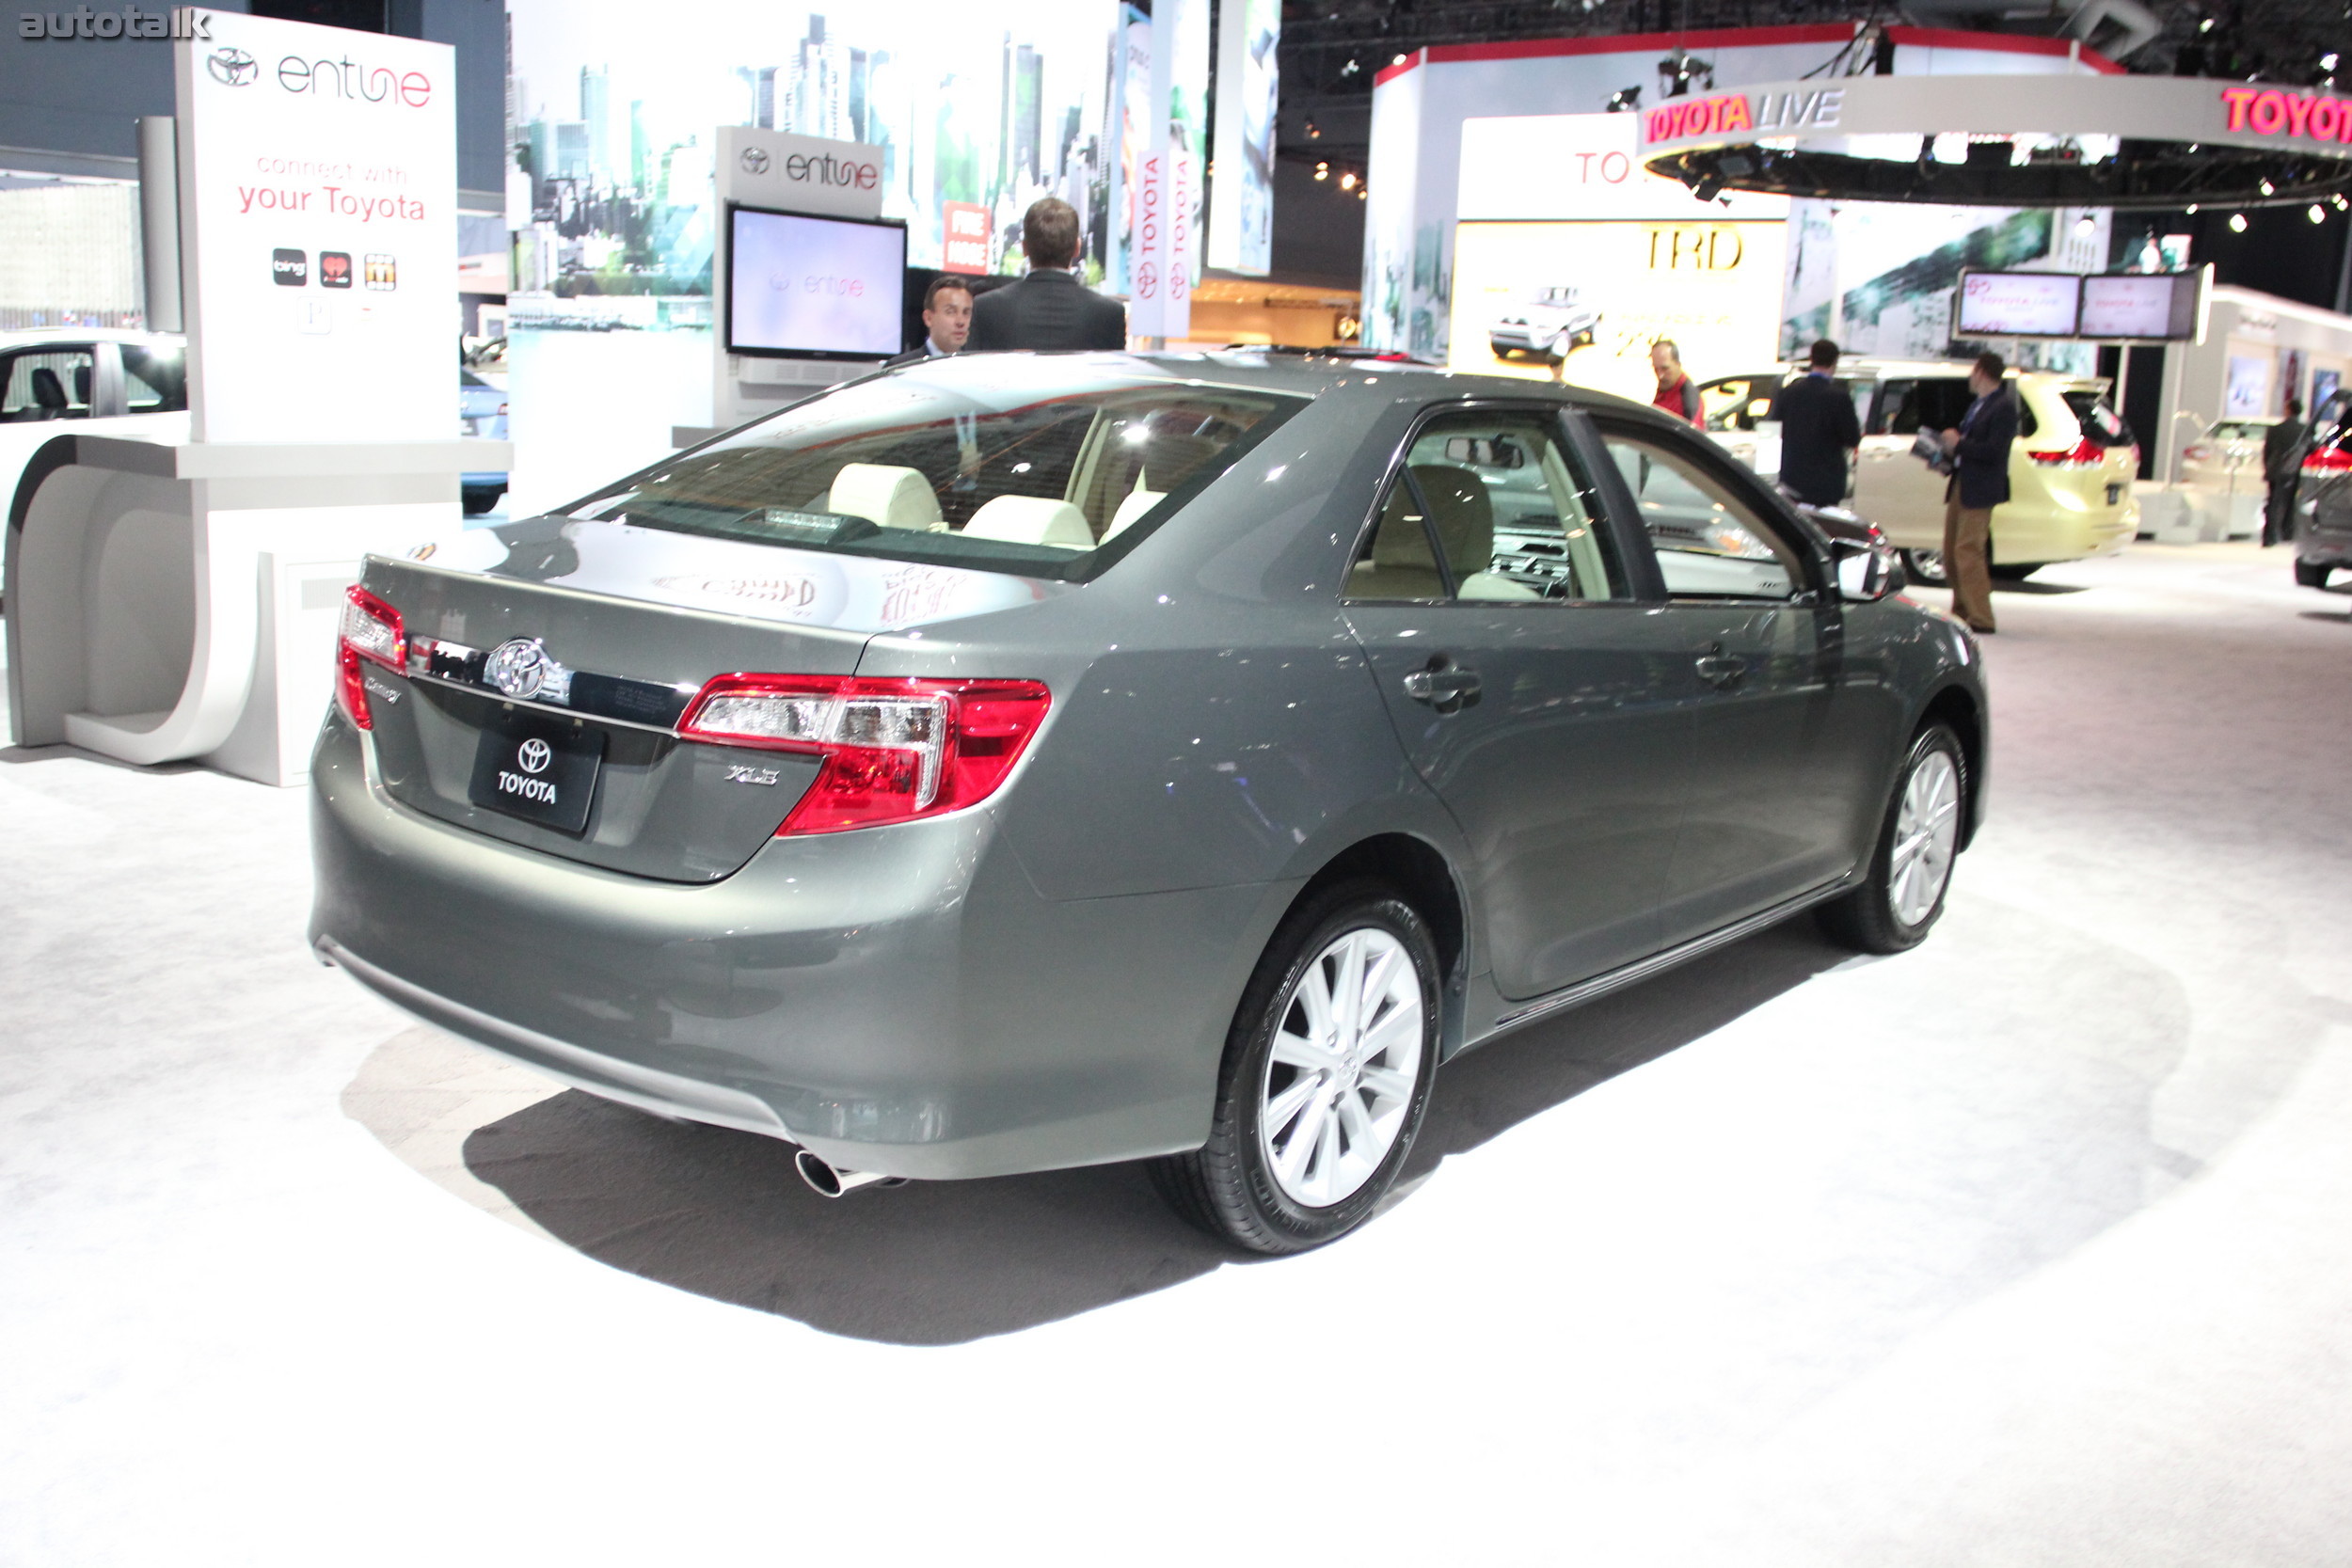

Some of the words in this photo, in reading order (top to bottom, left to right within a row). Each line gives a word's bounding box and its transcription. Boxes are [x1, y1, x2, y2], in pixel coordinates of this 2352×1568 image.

[278, 55, 431, 108] entune
[1643, 93, 1752, 144] TOYOTA
[1757, 88, 1846, 131] LIVE
[257, 157, 352, 180] connect
[365, 167, 407, 184] with
[787, 152, 878, 190] entune
[239, 186, 311, 214] your
[323, 186, 424, 222] Toyota
[1141, 156, 1159, 255] TOYOTA
[1173, 160, 1187, 255] TOYOTA
[274, 260, 306, 277] bing
[1645, 229, 1743, 271] TRD
[804, 276, 864, 297] entune
[499, 771, 556, 804] TOYOTA
[723, 765, 781, 785] XLE
